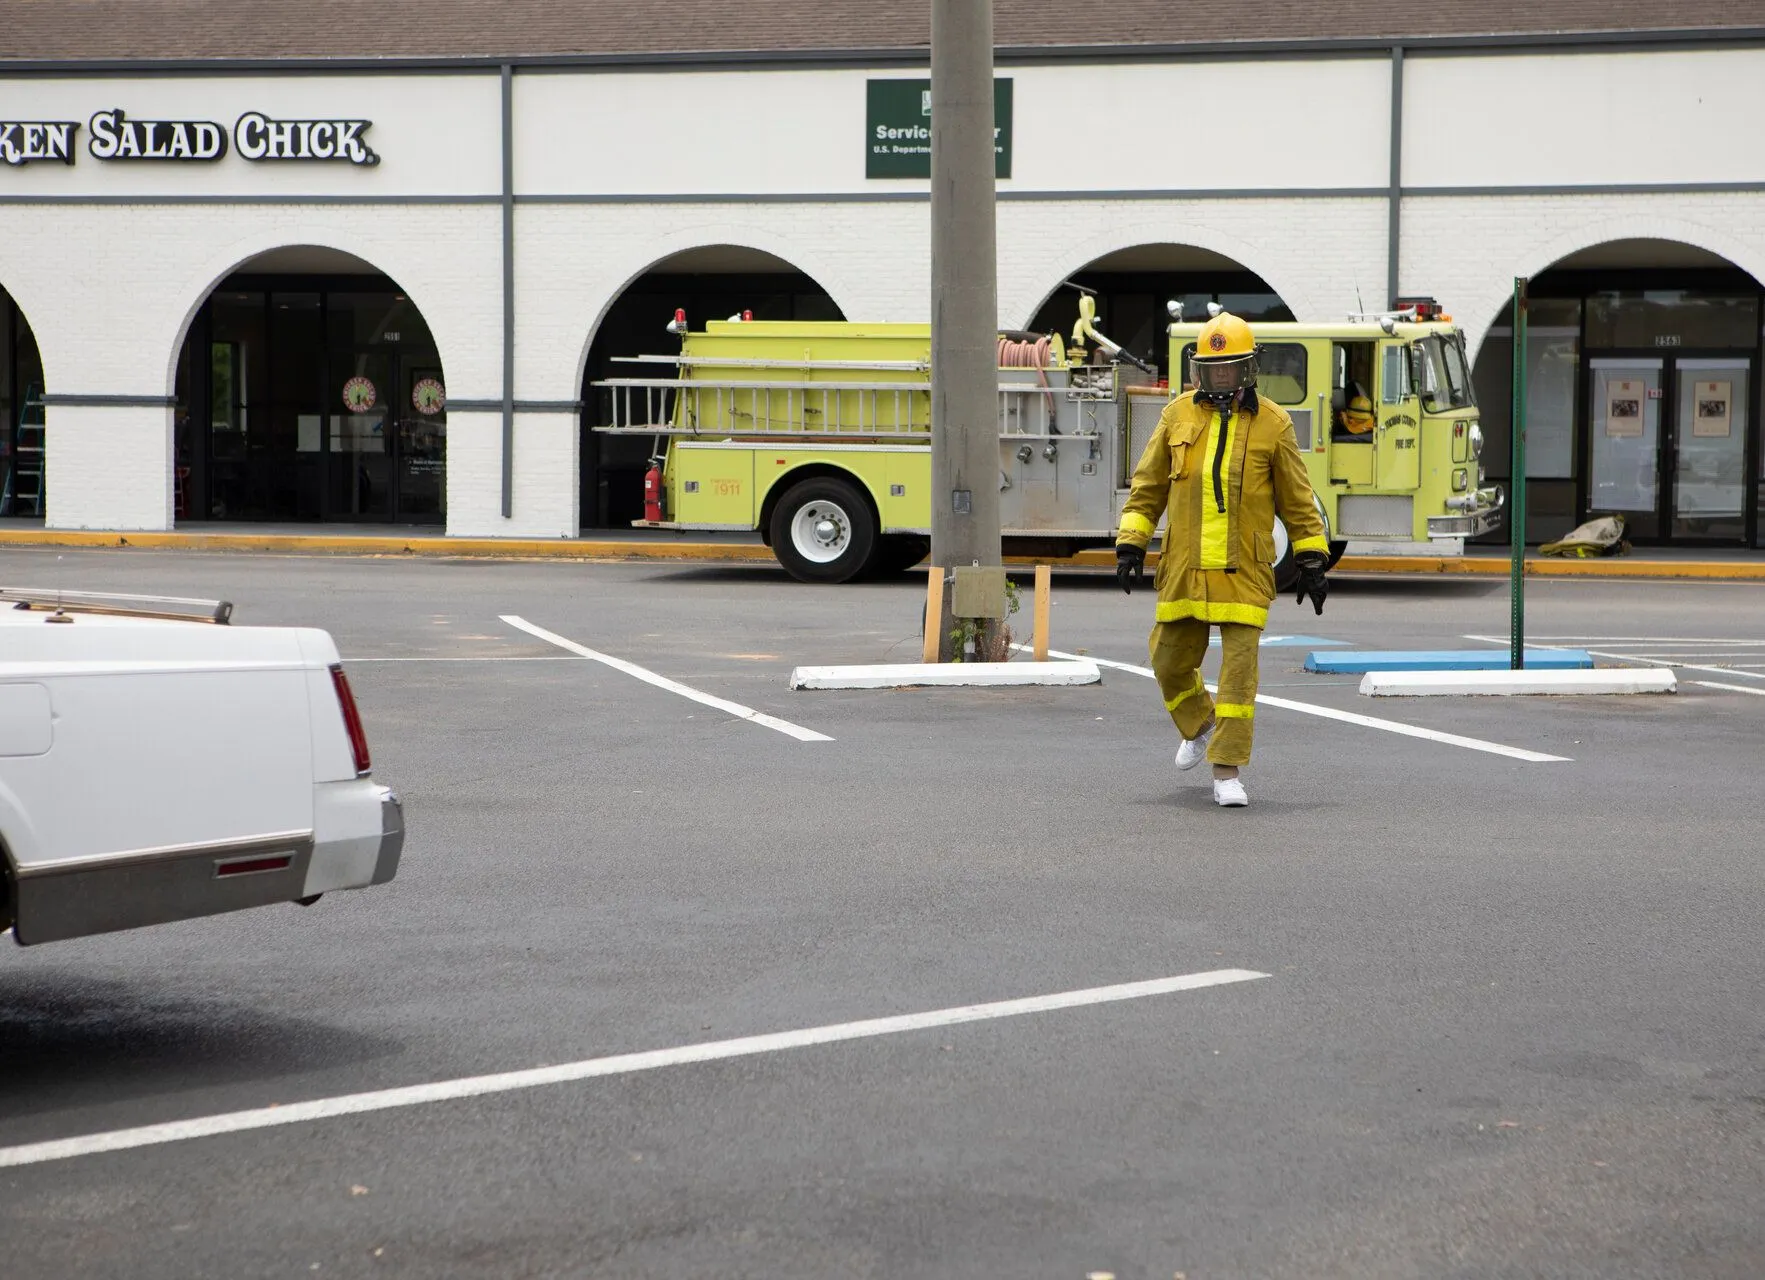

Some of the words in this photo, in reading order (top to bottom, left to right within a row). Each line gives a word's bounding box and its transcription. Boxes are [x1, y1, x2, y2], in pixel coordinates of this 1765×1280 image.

[90, 112, 220, 158] SALAD
[873, 145, 890, 154] U.S.
[719, 484, 740, 496] 911
